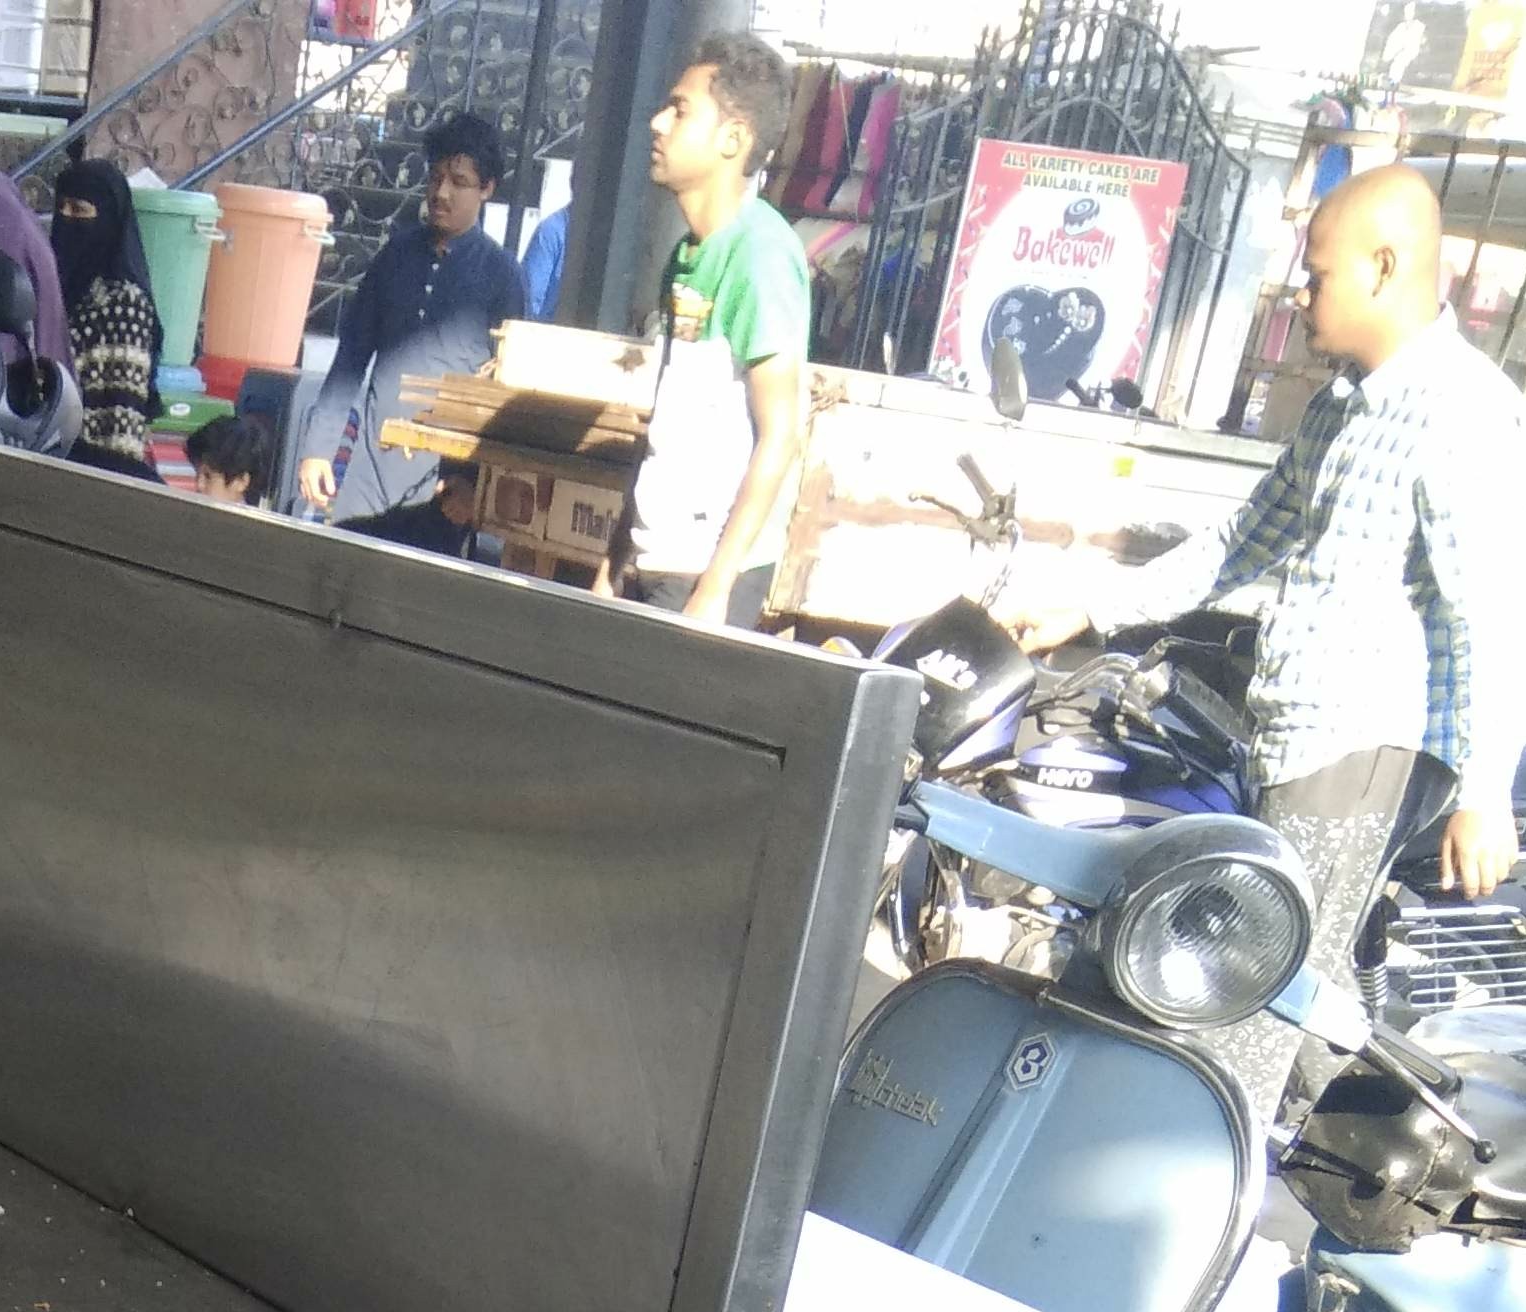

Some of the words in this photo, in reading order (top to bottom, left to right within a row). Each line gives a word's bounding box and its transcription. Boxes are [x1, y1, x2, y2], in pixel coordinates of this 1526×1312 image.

[1004, 151, 1026, 168] ALL
[1031, 154, 1084, 173] VARIETY
[1088, 161, 1130, 180] CAKES
[1133, 166, 1159, 183] ARE
[1023, 173, 1092, 194] AVAILABLE
[1096, 182, 1129, 197] HERE
[1013, 225, 1116, 268] Bakewell
